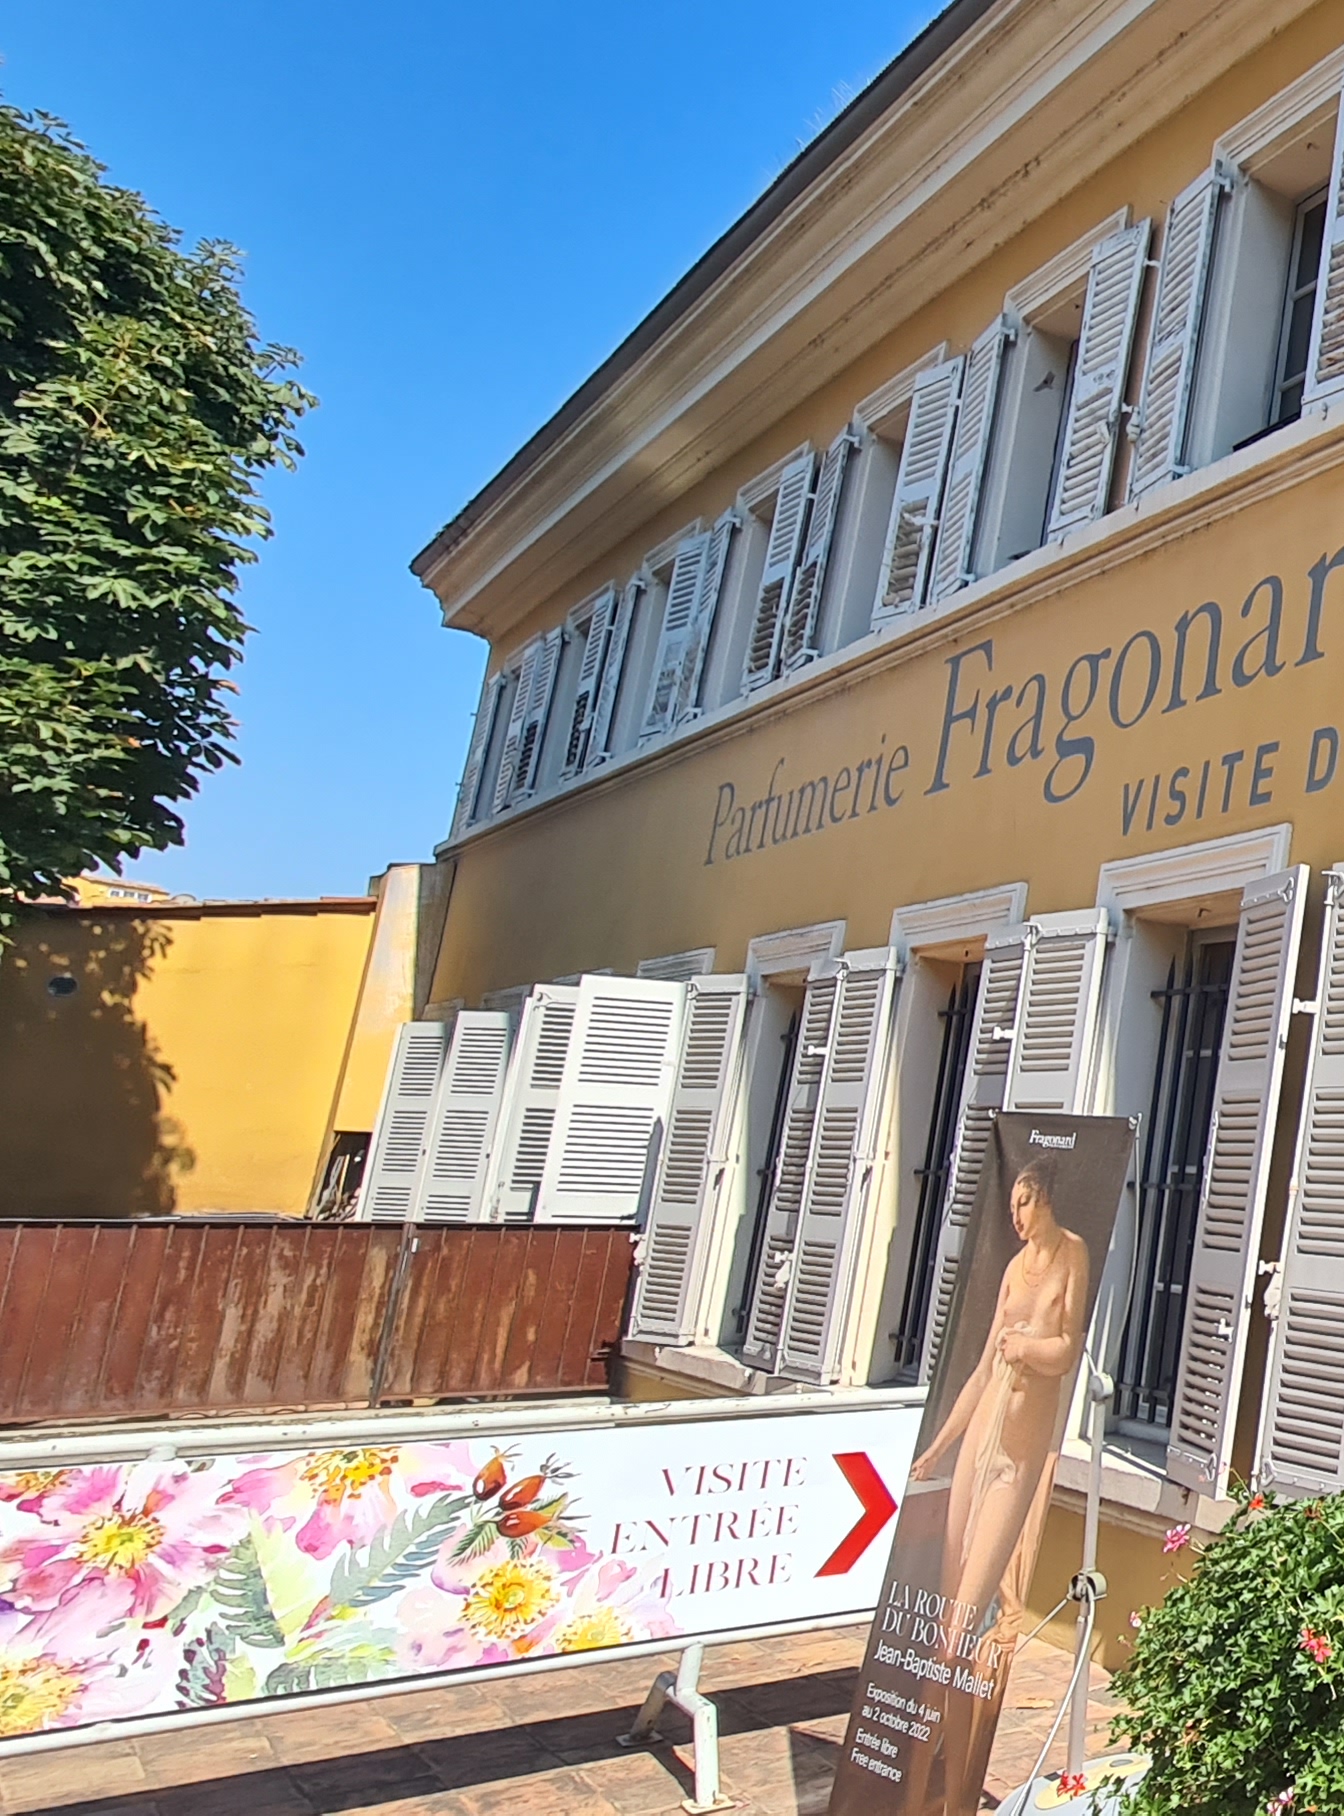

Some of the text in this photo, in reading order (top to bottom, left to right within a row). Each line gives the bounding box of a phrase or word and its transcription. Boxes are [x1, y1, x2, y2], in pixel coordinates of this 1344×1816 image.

[703, 732, 910, 866] Parfumerie
[1121, 740, 1280, 836] VISITE
[1029, 1129, 1077, 1148] Fragonard
[661, 1456, 807, 1497] VISITE
[610, 1501, 799, 1554] ENTRÉE
[659, 1553, 792, 1599] LIBRE
[888, 1581, 977, 1631] LA ROUTE
[881, 1607, 1001, 1669] DU BONHEUR
[873, 1639, 994, 1700] Jean-Baptiste Mallet
[861, 1704, 931, 1742] au 2 octobre 2022
[866, 1682, 941, 1723] Exposition du 4 juin
[850, 1747, 903, 1783] Free entrance
[855, 1728, 899, 1758] Entrée libre
